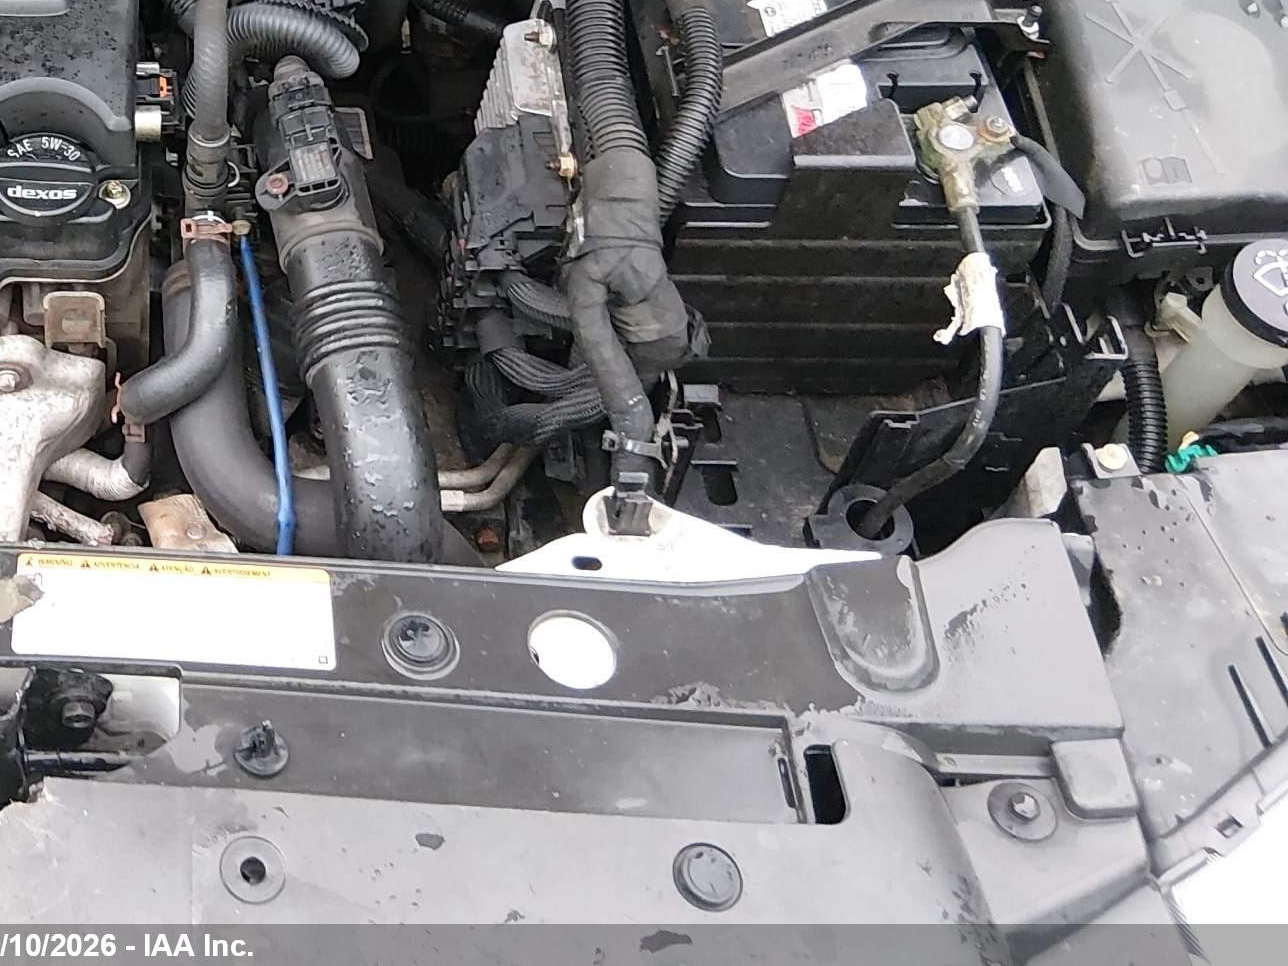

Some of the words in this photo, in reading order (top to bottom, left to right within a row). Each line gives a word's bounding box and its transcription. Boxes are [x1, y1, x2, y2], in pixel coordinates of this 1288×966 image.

[7, 138, 34, 158] SAE
[41, 136, 81, 161] 5W-30
[7, 185, 78, 200] dexos
